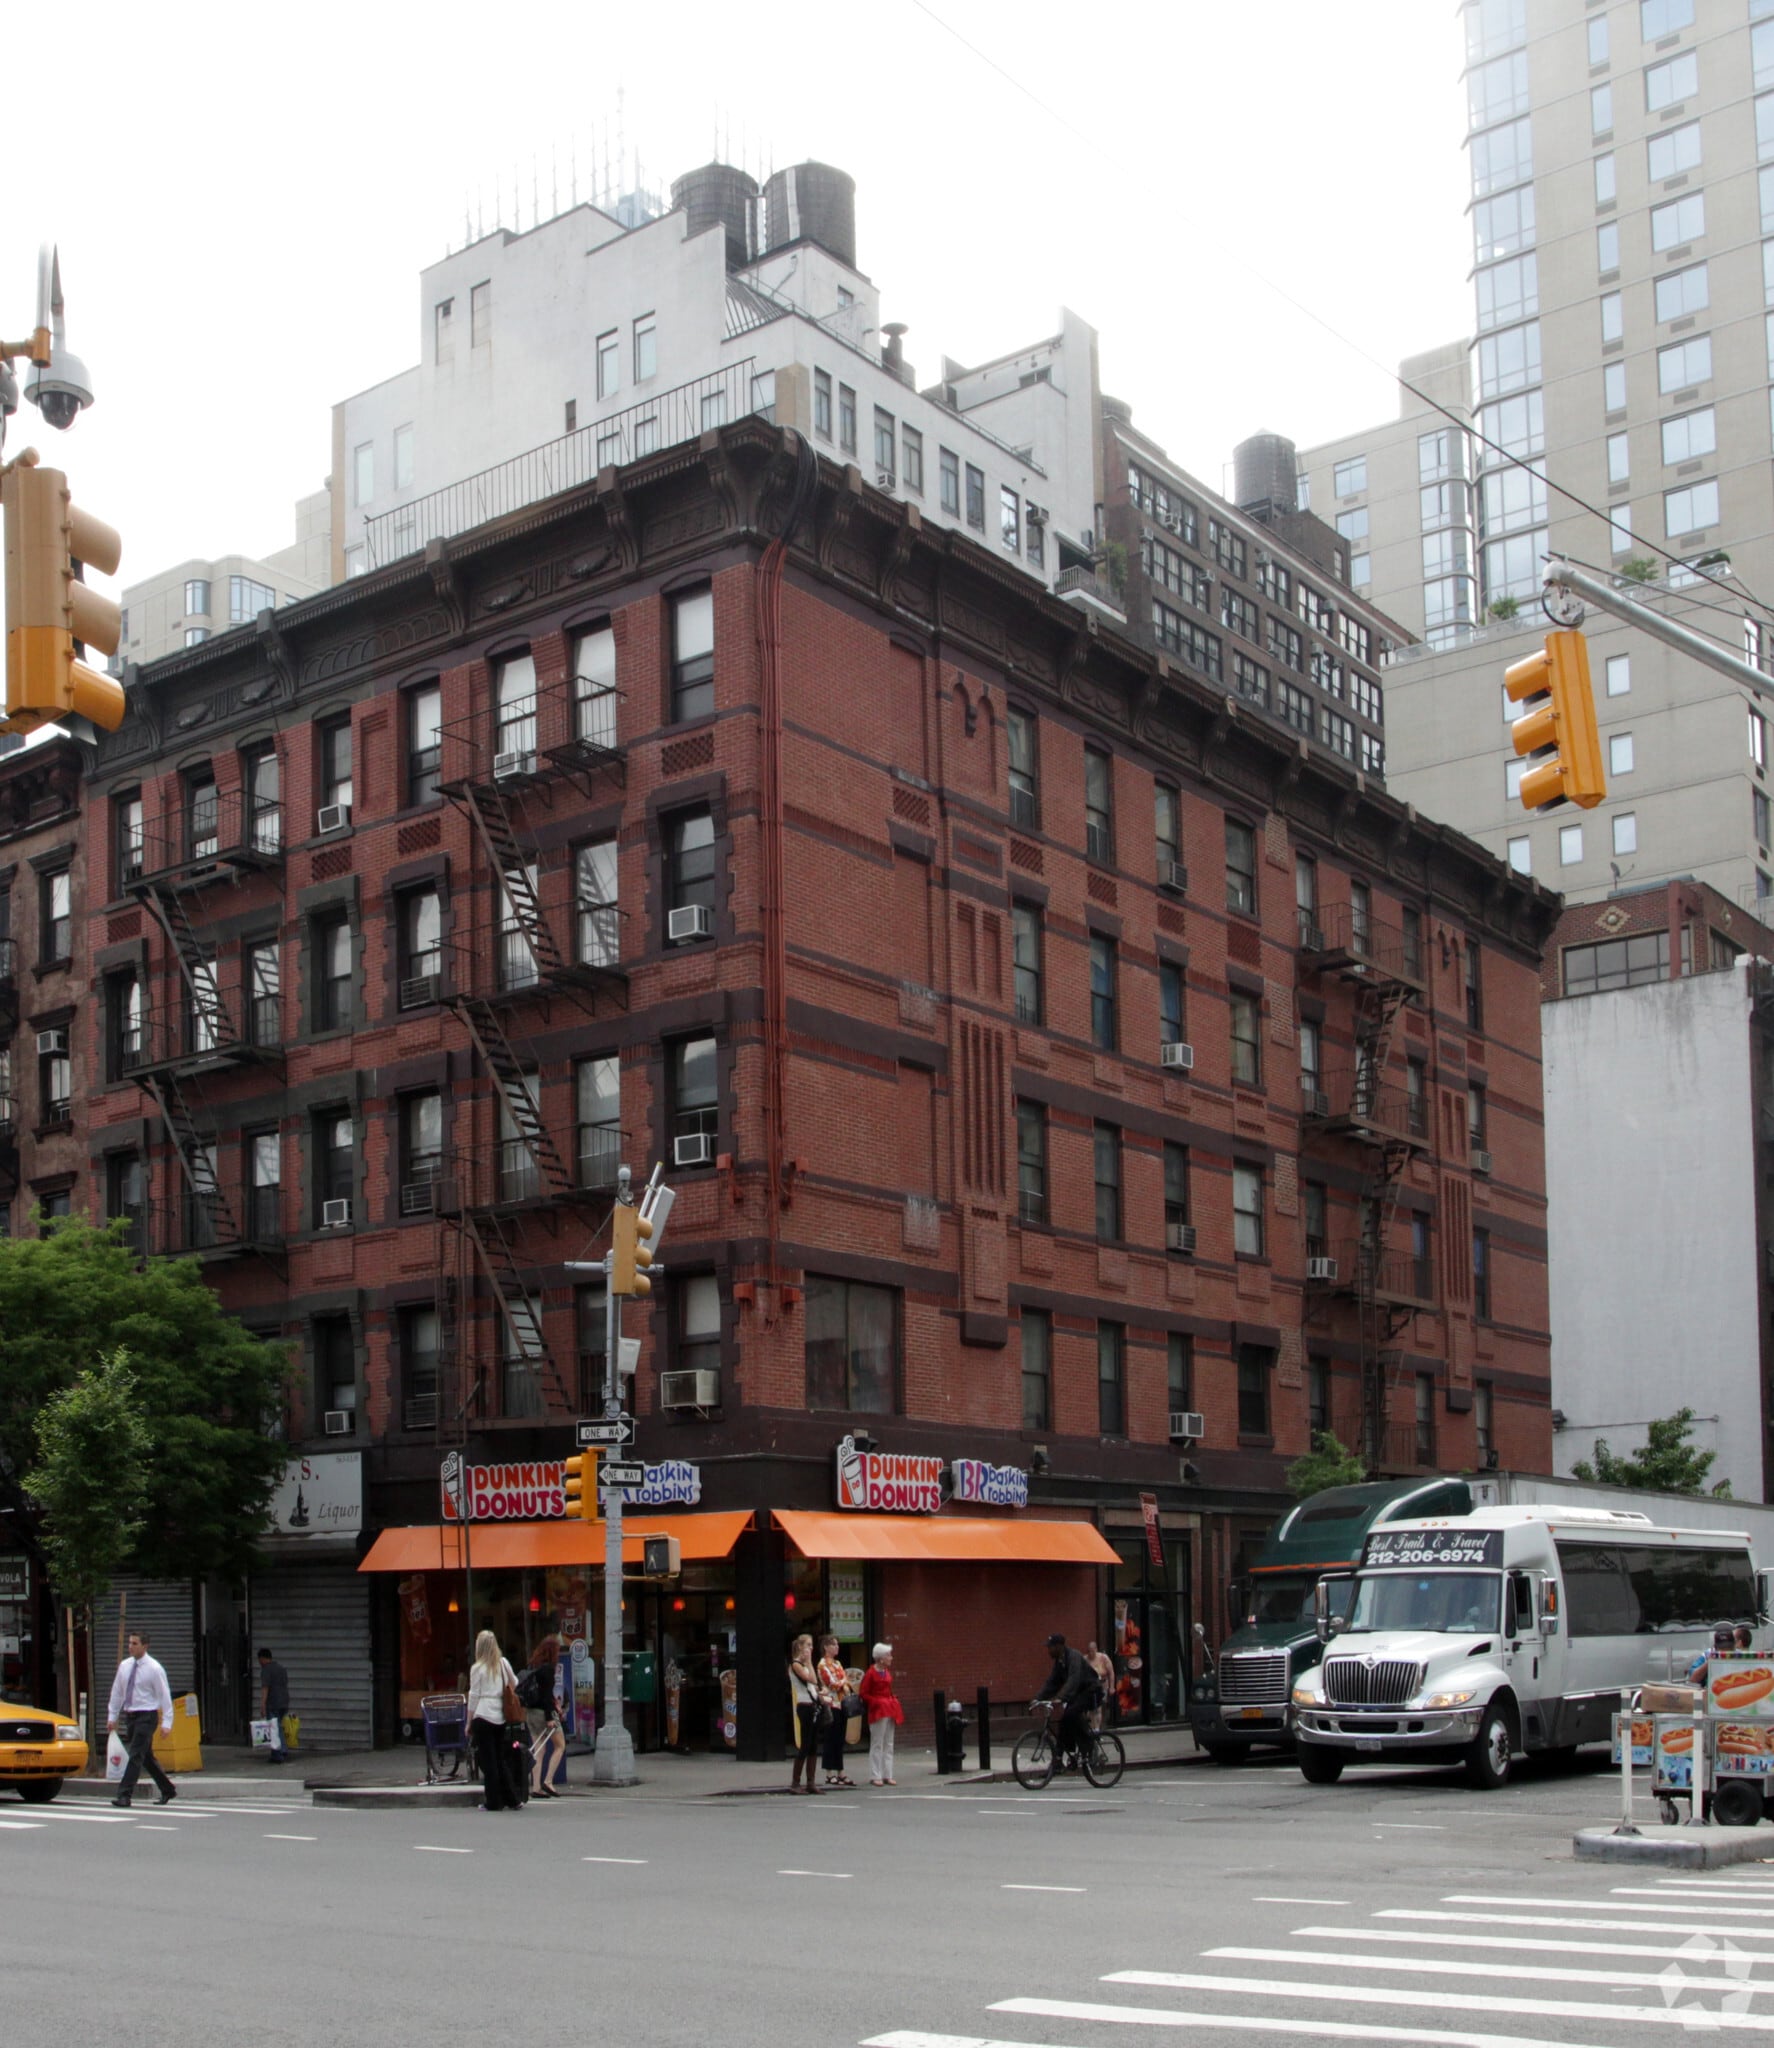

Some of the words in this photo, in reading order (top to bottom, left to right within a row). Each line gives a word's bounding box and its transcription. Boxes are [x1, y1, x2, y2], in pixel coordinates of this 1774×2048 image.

[585, 1428, 601, 1438] ONE
[608, 1427, 625, 1437] WAY
[474, 1462, 566, 1490] DUNKIN'
[603, 1470, 618, 1480] ONE
[624, 1471, 638, 1480] WAY
[645, 1461, 693, 1483] askin
[870, 1456, 943, 1482] DUNKIN'
[987, 1466, 1027, 1487] baskin
[960, 1460, 988, 1500] BR
[476, 1490, 564, 1517] DONUTS
[870, 1483, 941, 1510] DONUTS
[987, 1486, 1027, 1505] robbins
[318, 1503, 360, 1524] Liquor
[1367, 1534, 1392, 1552] Best
[1432, 1532, 1444, 1548] &
[1451, 1532, 1491, 1549] Travel
[1366, 1549, 1485, 1565] 212-206-6974
